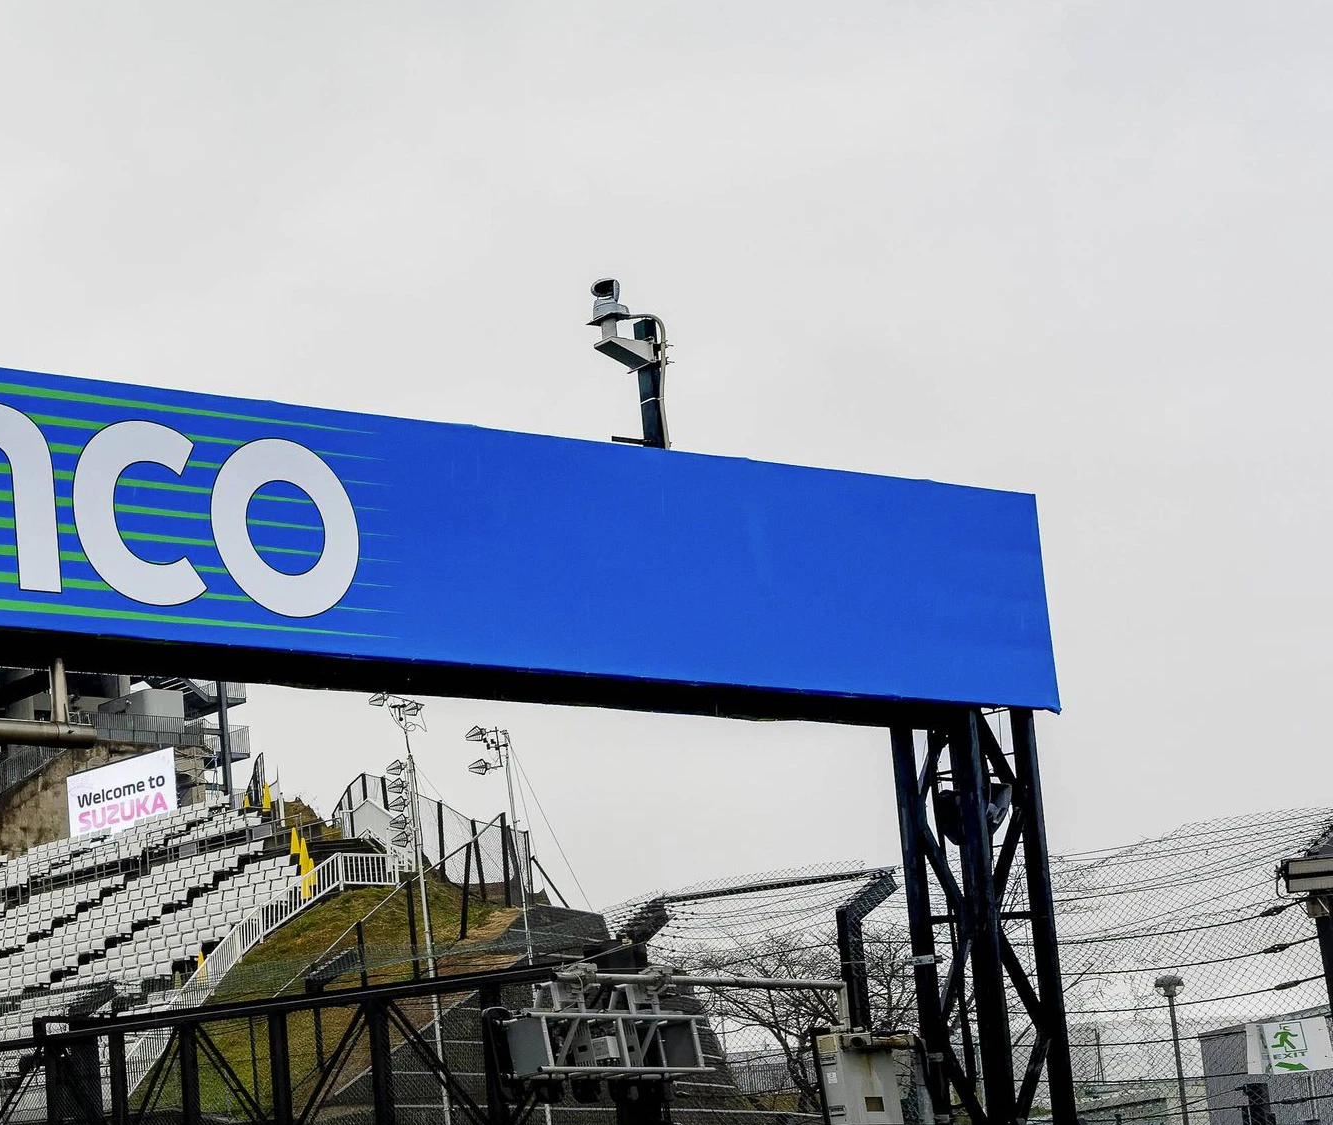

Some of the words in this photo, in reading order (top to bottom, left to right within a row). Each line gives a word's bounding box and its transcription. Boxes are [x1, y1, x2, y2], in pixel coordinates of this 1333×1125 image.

[77, 780, 145, 808] Welcome
[148, 775, 165, 789] to
[78, 792, 168, 833] SUZUKA
[1274, 1051, 1308, 1059] EXIT
